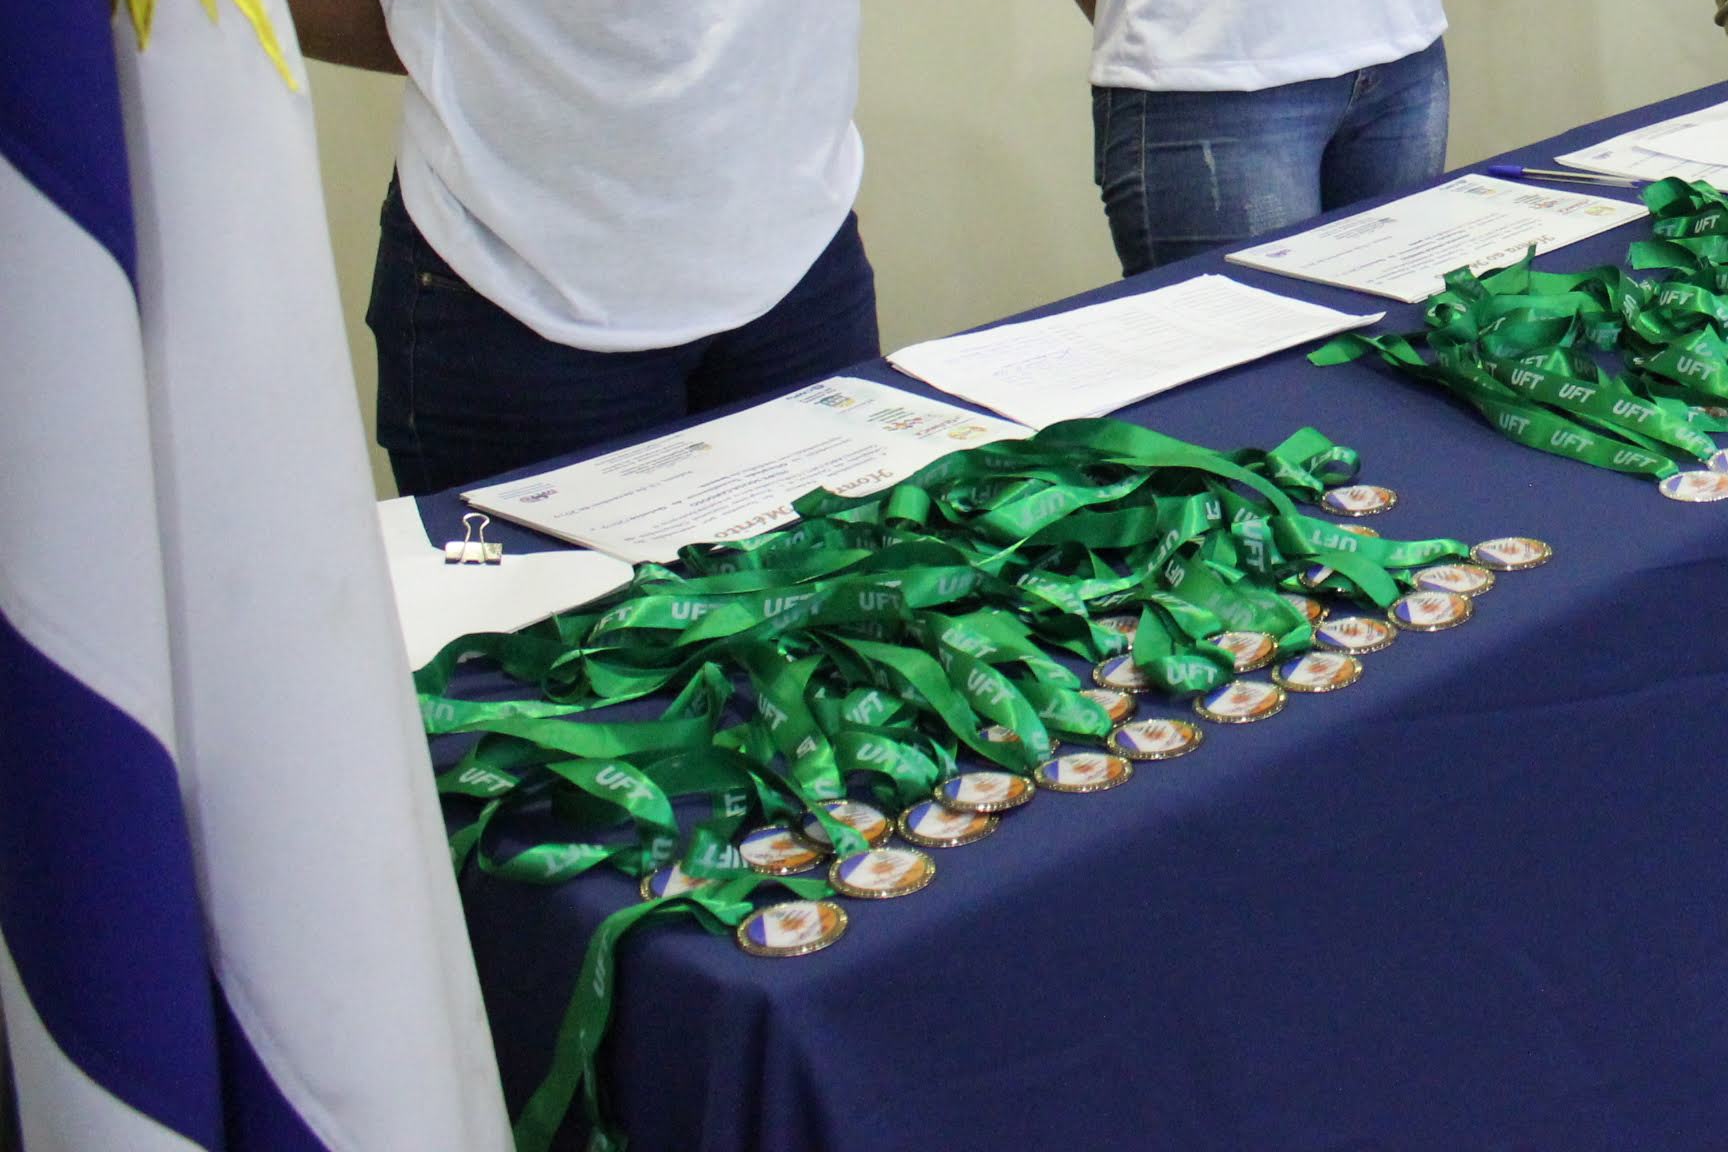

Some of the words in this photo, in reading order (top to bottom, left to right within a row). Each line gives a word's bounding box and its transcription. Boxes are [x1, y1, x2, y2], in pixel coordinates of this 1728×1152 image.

[1694, 214, 1721, 234] UFT
[1659, 290, 1697, 306] UFT
[1511, 369, 1544, 390] UFT
[1677, 357, 1716, 381] UFT
[1559, 384, 1596, 404] UFT
[1612, 399, 1657, 423] UFT
[1499, 414, 1531, 435] UFT
[1551, 430, 1594, 452] UFT
[1613, 450, 1657, 467] UFT
[838, 468, 894, 496] Honr
[1311, 529, 1358, 554] UFT
[859, 591, 900, 611] UFT
[1166, 662, 1219, 686] UFT
[968, 668, 1013, 705] UFT
[459, 767, 516, 792] UFT
[596, 765, 654, 801] UFT
